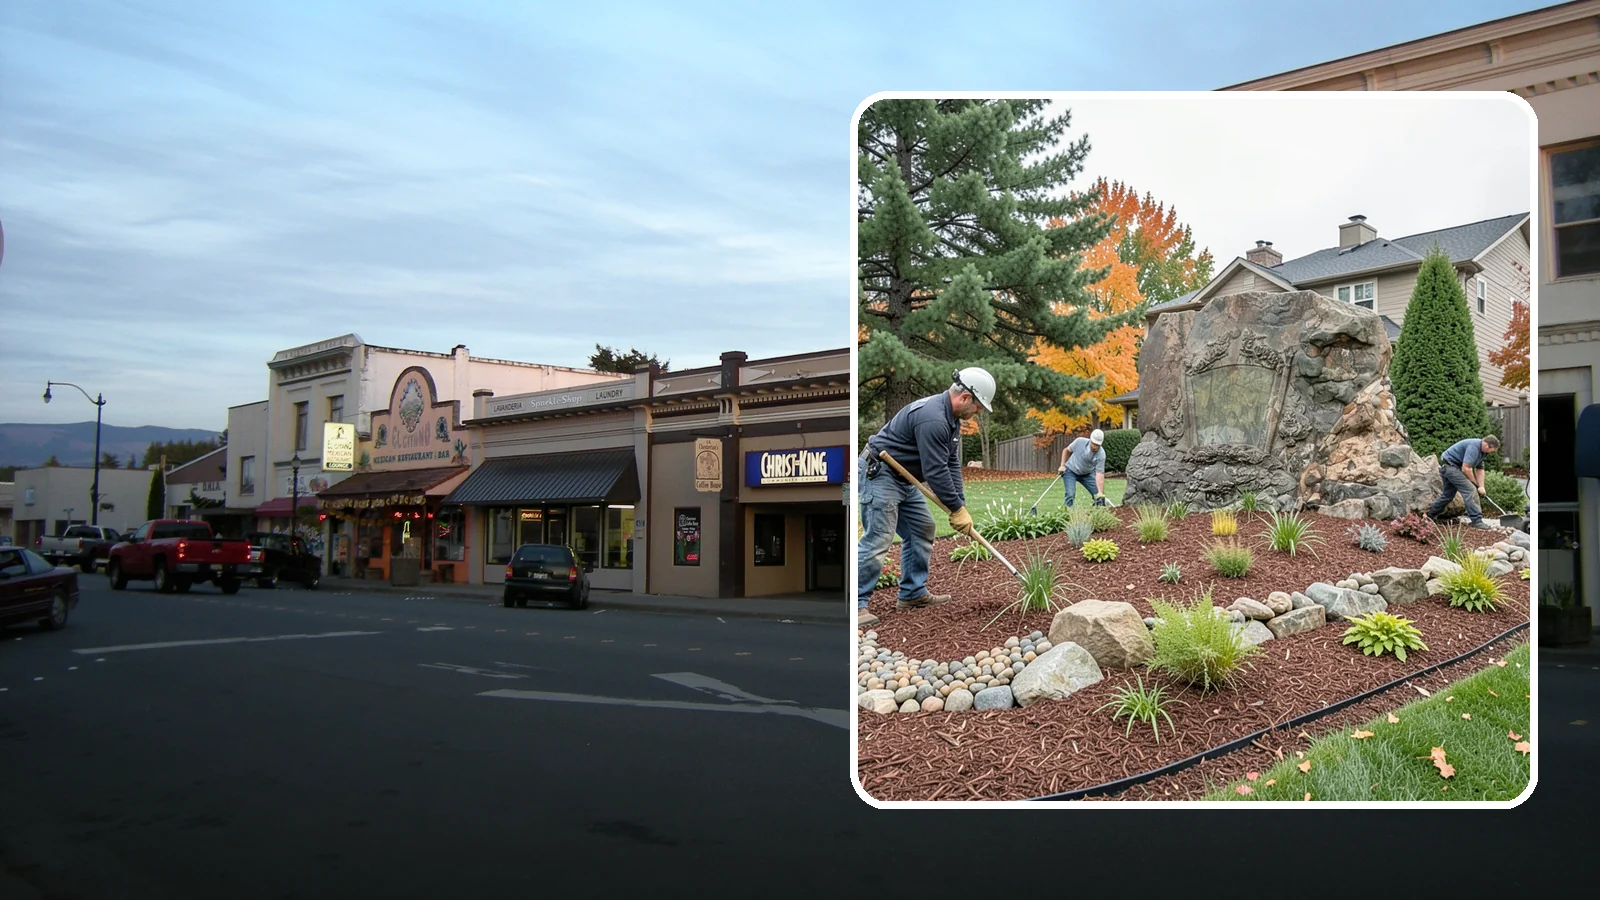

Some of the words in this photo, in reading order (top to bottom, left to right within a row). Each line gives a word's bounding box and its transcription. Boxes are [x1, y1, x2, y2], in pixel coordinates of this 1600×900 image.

[530, 397, 560, 409] Sparkle
[561, 394, 582, 405] Shop
[595, 389, 623, 400] LAUNDRY
[493, 402, 522, 412] LAVANDERIA
[373, 454, 396, 464] MEXICAN
[397, 451, 433, 462] RESTAURANT
[437, 450, 450, 459] BAR
[761, 452, 797, 477] CHRIST
[799, 450, 827, 476] KING
